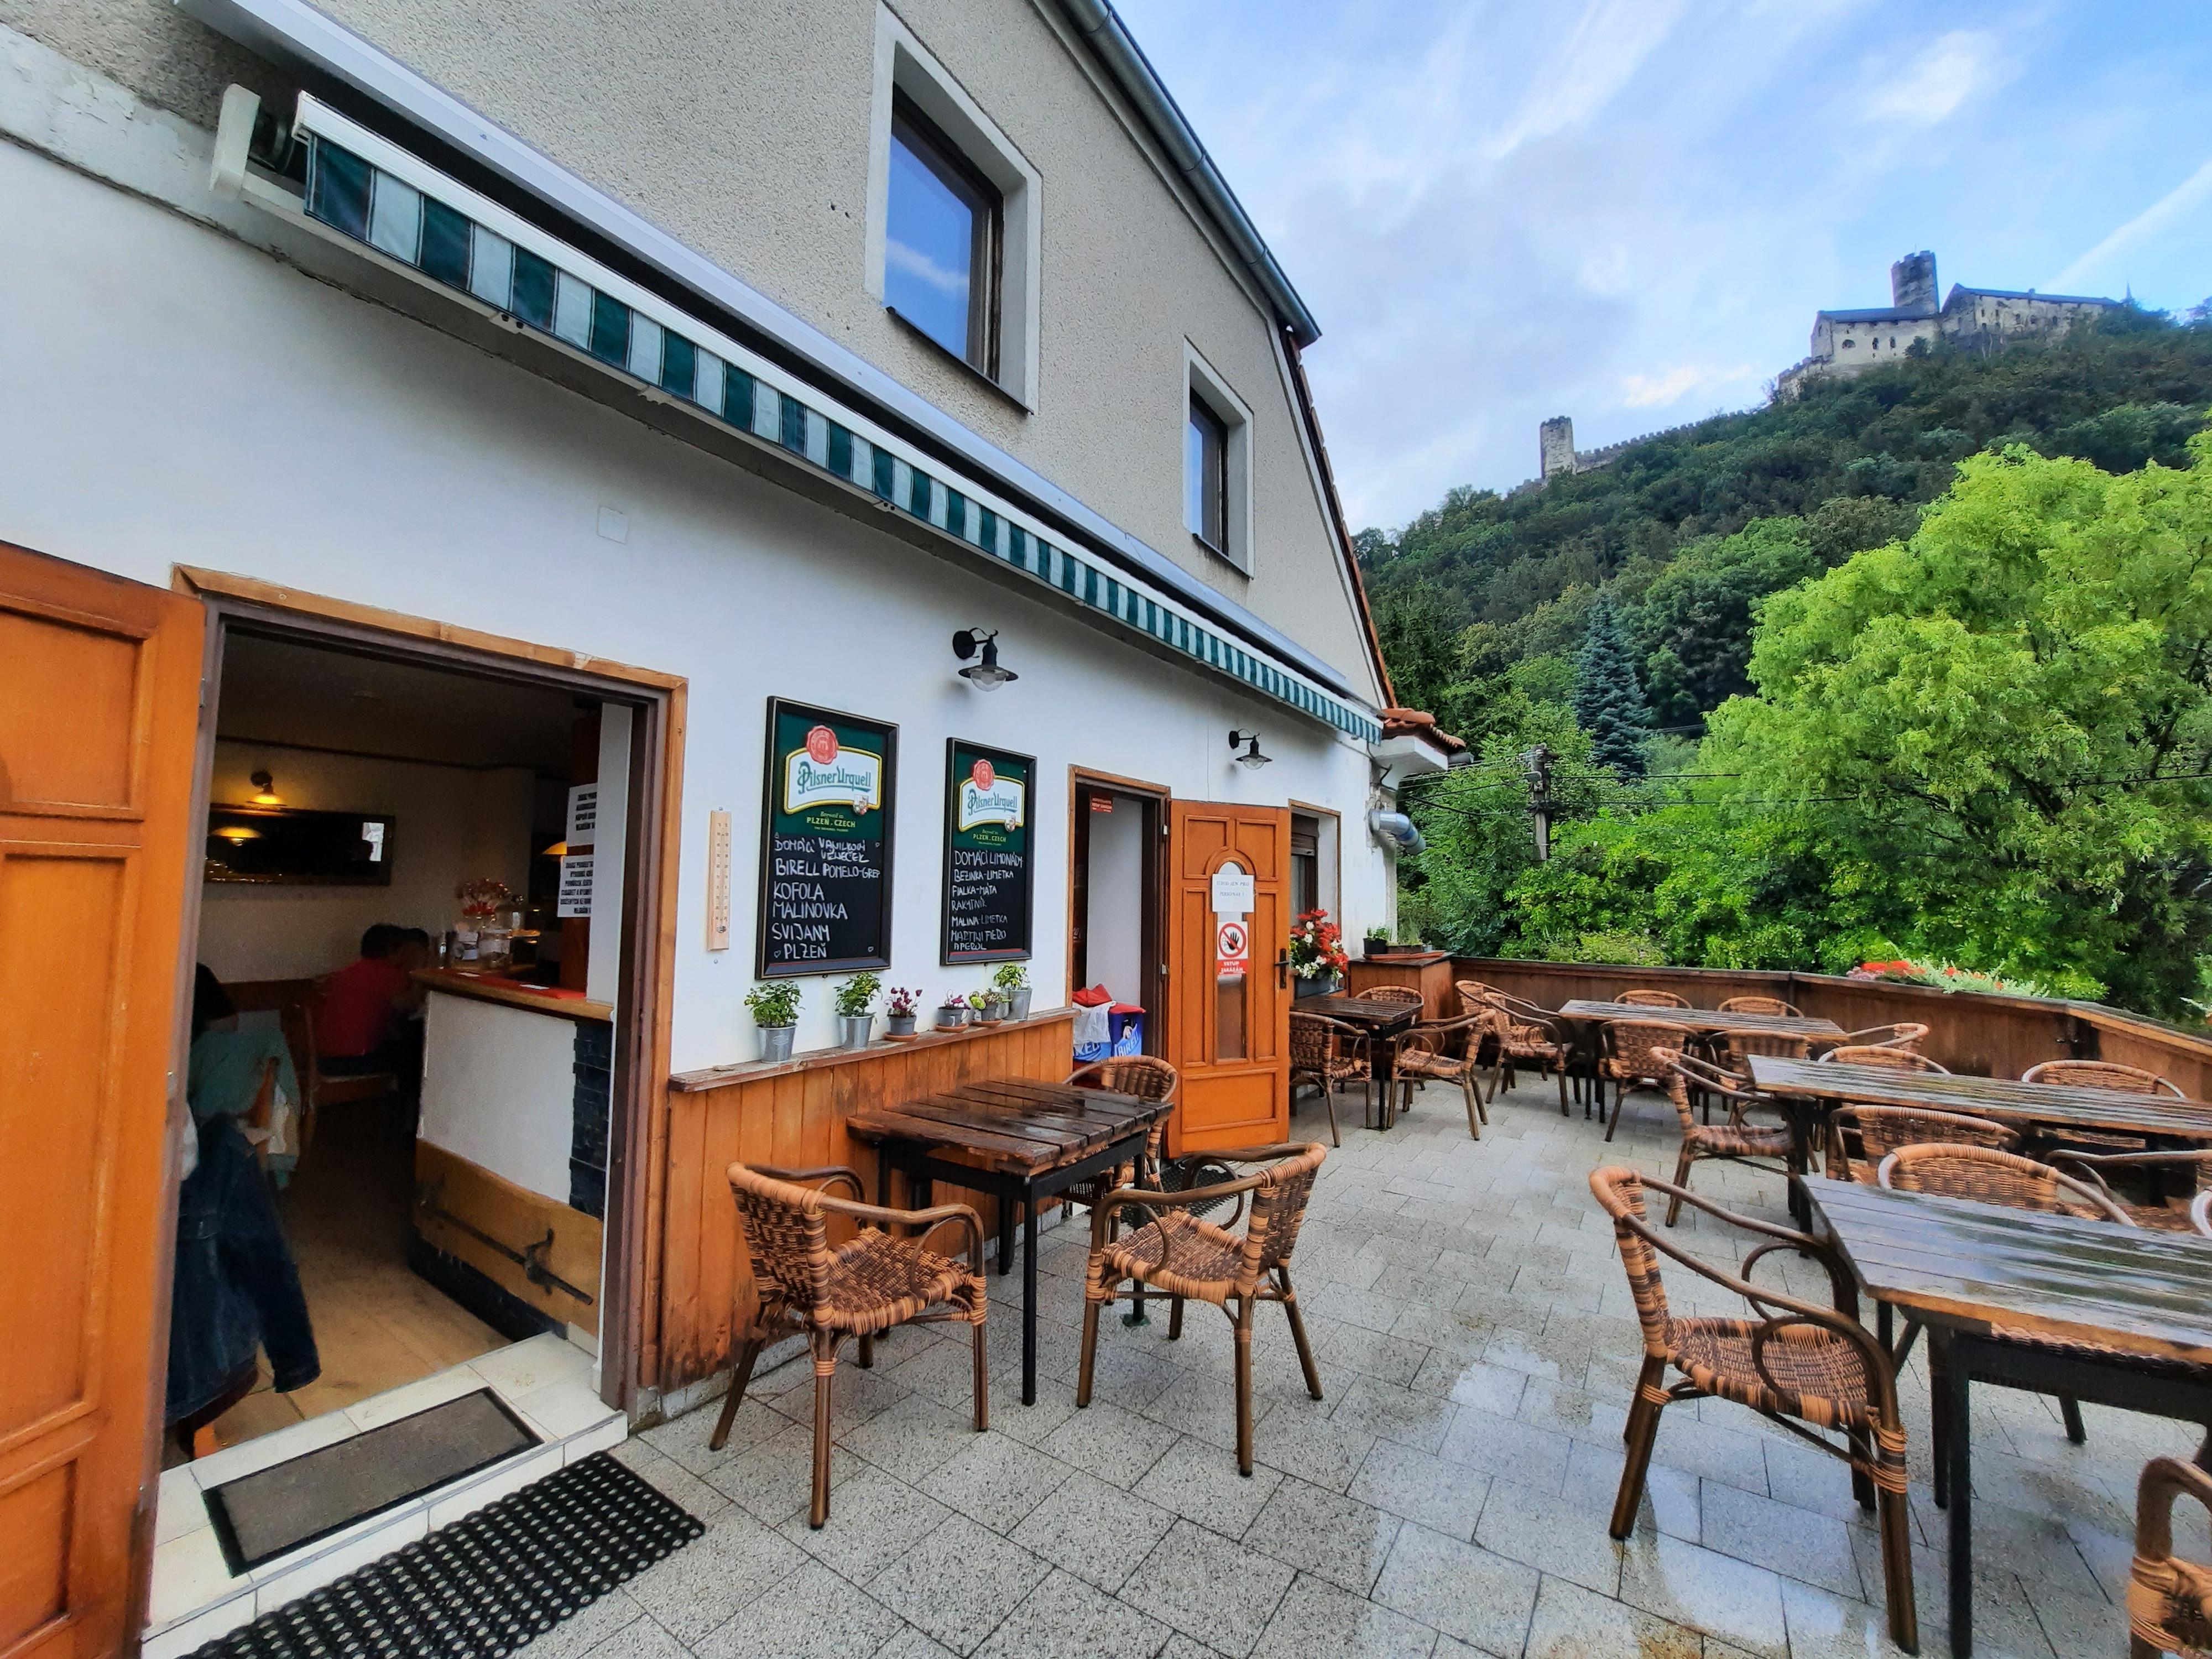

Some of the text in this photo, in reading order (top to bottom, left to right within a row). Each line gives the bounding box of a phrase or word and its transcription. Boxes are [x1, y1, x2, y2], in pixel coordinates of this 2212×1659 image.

[797, 761, 871, 795] Pilsner Urquell
[968, 789, 1018, 816] Pilsner Urquell
[834, 820, 855, 828] CZECH
[954, 849, 988, 867] DOMÁCÍ
[776, 858, 880, 879] BIRELL POMELO-GREP
[774, 881, 825, 901] KOFOLA
[952, 882, 998, 897] FIALKA-MÁTA
[773, 901, 848, 920] MALINOVKA
[951, 896, 987, 911] RAKYTNÍK
[952, 914, 1008, 927] MALINA-LIMETKA
[771, 922, 830, 942] SVIJANY
[951, 930, 983, 942] MARTINI
[784, 943, 827, 959] PLZEŇ
[954, 942, 987, 951] APEROL
